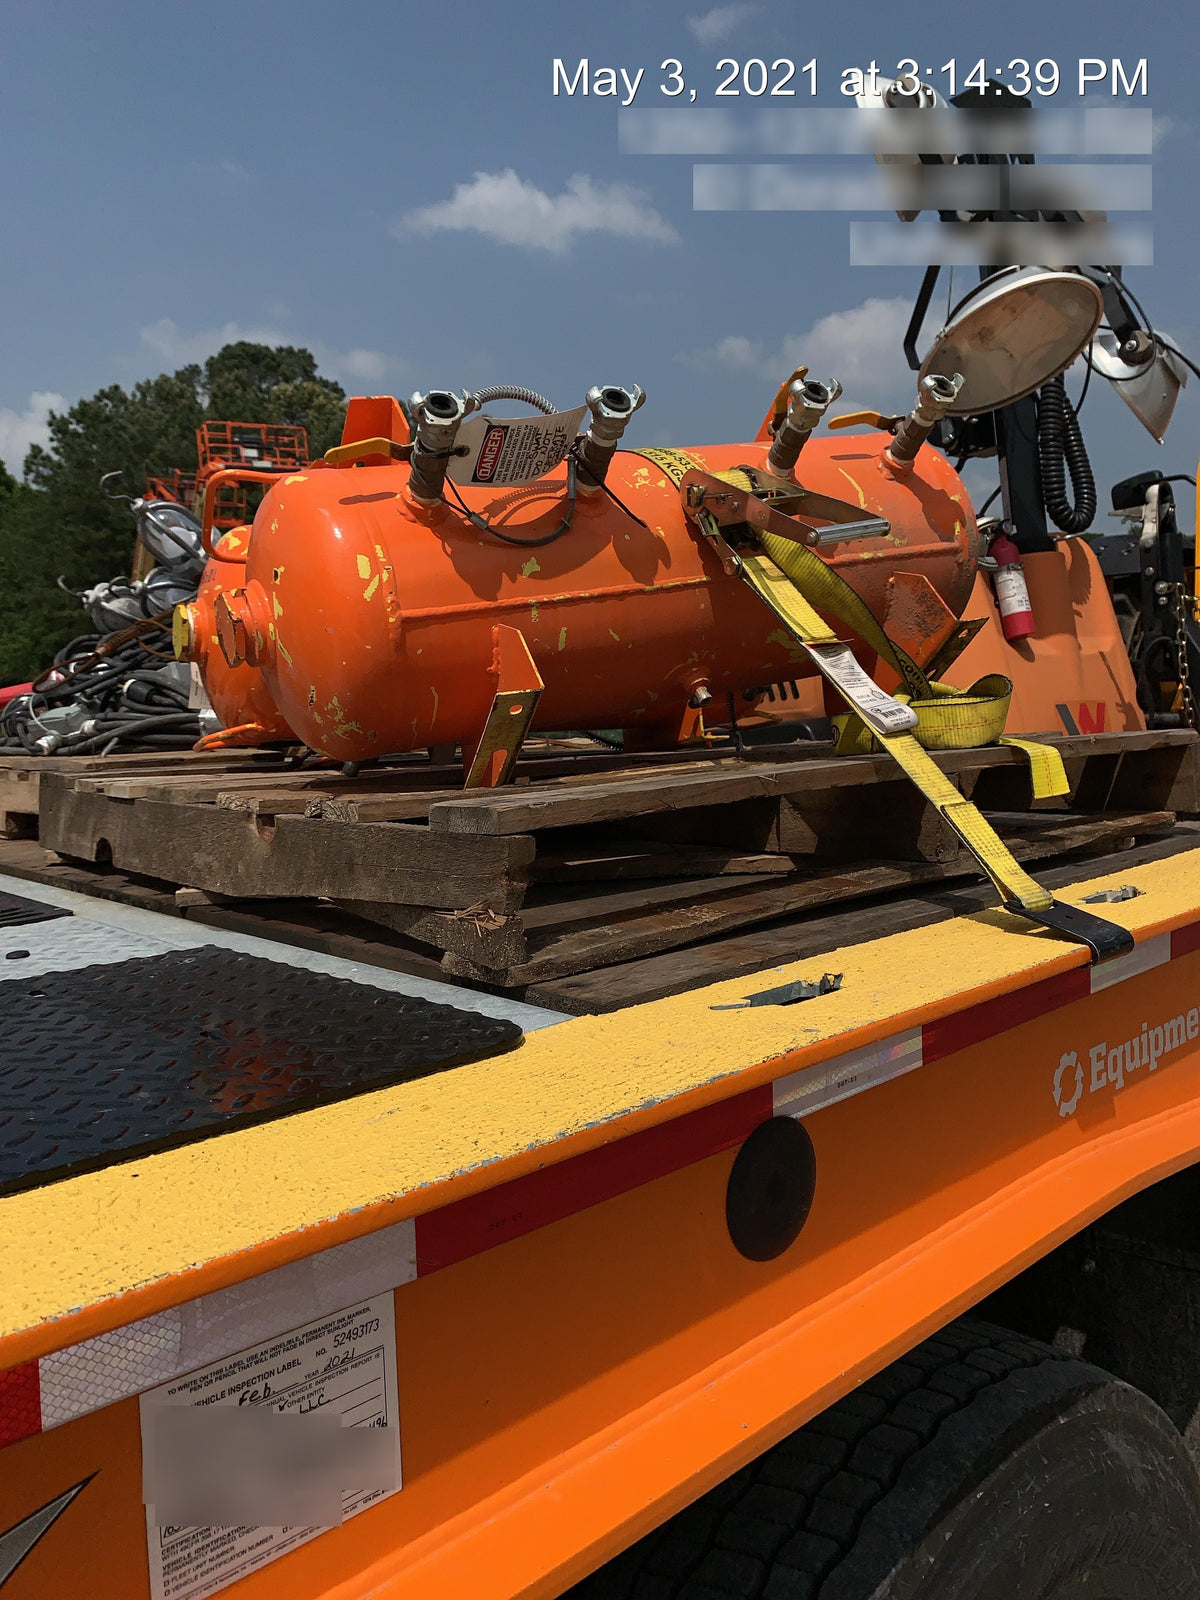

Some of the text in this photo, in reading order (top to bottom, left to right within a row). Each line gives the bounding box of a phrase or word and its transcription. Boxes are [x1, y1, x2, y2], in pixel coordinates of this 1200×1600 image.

[479, 430, 502, 478] DANGER
[499, 450, 509, 469] ENERGY
[505, 427, 515, 449] SOURCE
[504, 459, 512, 473] BEEN
[508, 438, 518, 459] LOCKED
[532, 429, 553, 479] DO NOT
[543, 425, 564, 473] OPERATE
[1089, 1007, 1200, 1092] Equipme
[167, 1305, 371, 1396] TO WRITE ON THIS LABEL USE AN INDELIBLE, PERMANENT INK MARKER,
[189, 1383, 202, 1393] PEN
[204, 1378, 213, 1387] OR
[214, 1368, 236, 1382] PENCIL
[237, 1361, 252, 1372] THAT
[254, 1355, 267, 1365] WILL
[269, 1349, 281, 1359] NOT
[282, 1342, 297, 1353] FADE
[305, 1330, 325, 1343] DIRECT
[327, 1318, 353, 1334] SUNLIGHT
[227, 1368, 274, 1395] INSPECTION
[276, 1357, 301, 1374] LABEL
[315, 1346, 327, 1357] NO.
[332, 1317, 379, 1349] 52493173
[323, 1347, 356, 1372] 2021
[239, 1383, 275, 1406] Feb.
[263, 1396, 285, 1406] NNUAL
[288, 1382, 312, 1398] VEHICLE
[314, 1366, 348, 1386] INSPECTION
[350, 1355, 372, 1370] REPORT
[304, 1369, 320, 1380] YEAR
[287, 1386, 325, 1408] OTHER ENTITY
[300, 1394, 331, 1414] LLC
[161, 1526, 210, 1556] CERTIFICATION
[161, 1548, 178, 1562] WITH
[162, 1551, 191, 1571] VEHICLE
[194, 1523, 245, 1554] IDENTIFICATION
[162, 1549, 207, 1578] PERMANENTLY
[171, 1568, 190, 1583] FLEET
[192, 1559, 206, 1572] UNIT
[208, 1544, 234, 1563] NUMBER
[172, 1573, 198, 1592] VEHICLE
[200, 1547, 246, 1578] IDENTIFICATION
[248, 1533, 273, 1551] NUMBER
